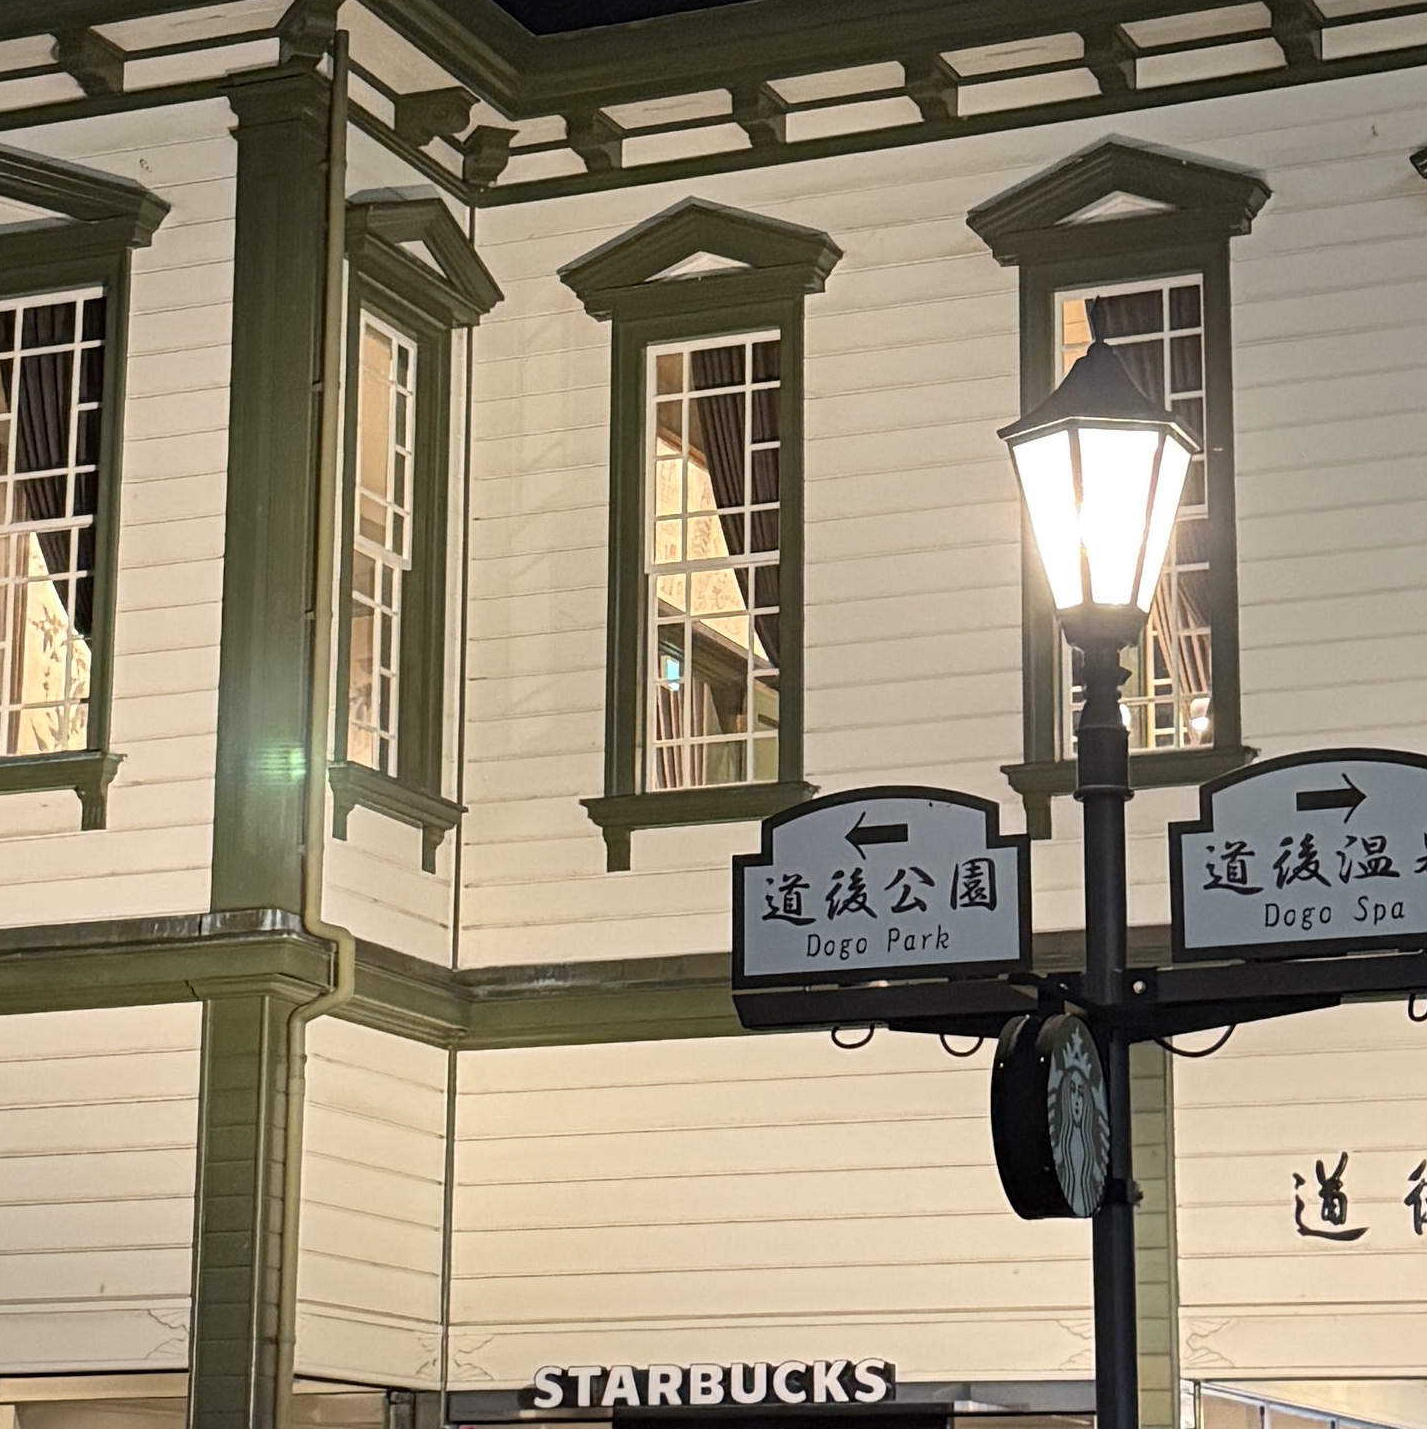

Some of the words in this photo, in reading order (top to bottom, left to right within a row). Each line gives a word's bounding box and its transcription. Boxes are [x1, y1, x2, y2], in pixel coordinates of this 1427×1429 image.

[761, 856, 1000, 926] 道後公園
[1263, 900, 1333, 930] Dogo
[1354, 895, 1406, 927] Spa
[805, 932, 869, 960] Dogo
[885, 924, 951, 952] Park
[532, 1358, 891, 1409] STARBUCKS
